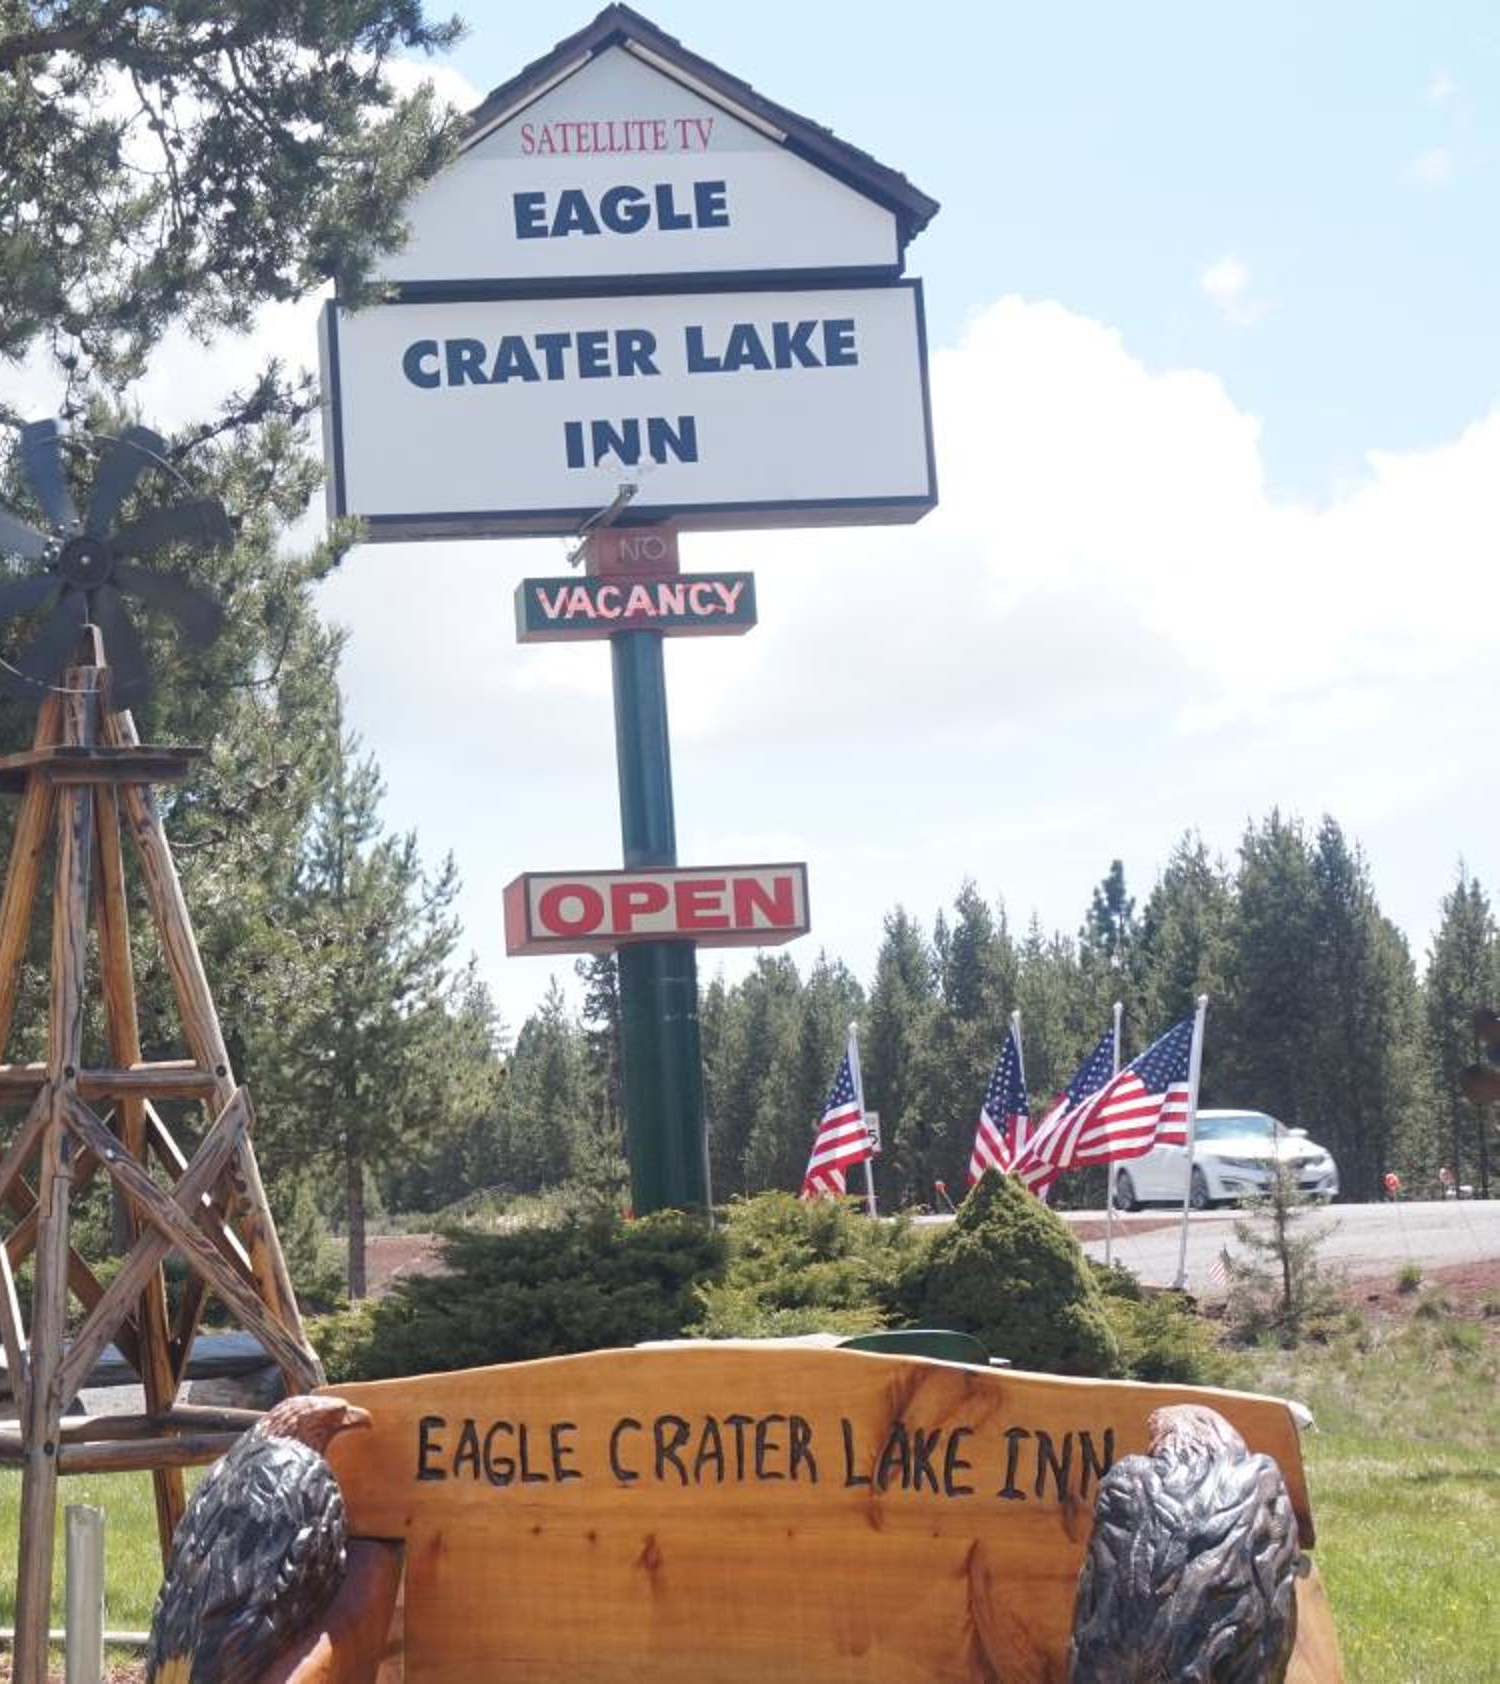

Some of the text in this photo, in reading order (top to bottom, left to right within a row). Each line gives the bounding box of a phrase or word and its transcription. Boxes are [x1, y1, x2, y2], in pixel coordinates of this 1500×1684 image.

[520, 117, 714, 155] SATELLITE TV
[513, 180, 730, 240] EAGLE
[401, 318, 859, 390] CRATER LAKE
[563, 415, 699, 469] INN
[620, 536, 667, 561] NO
[536, 581, 744, 620] VACANCY
[538, 875, 796, 936] OPEN
[415, 1414, 1115, 1503] EAGLE CRATER LAKE INN
